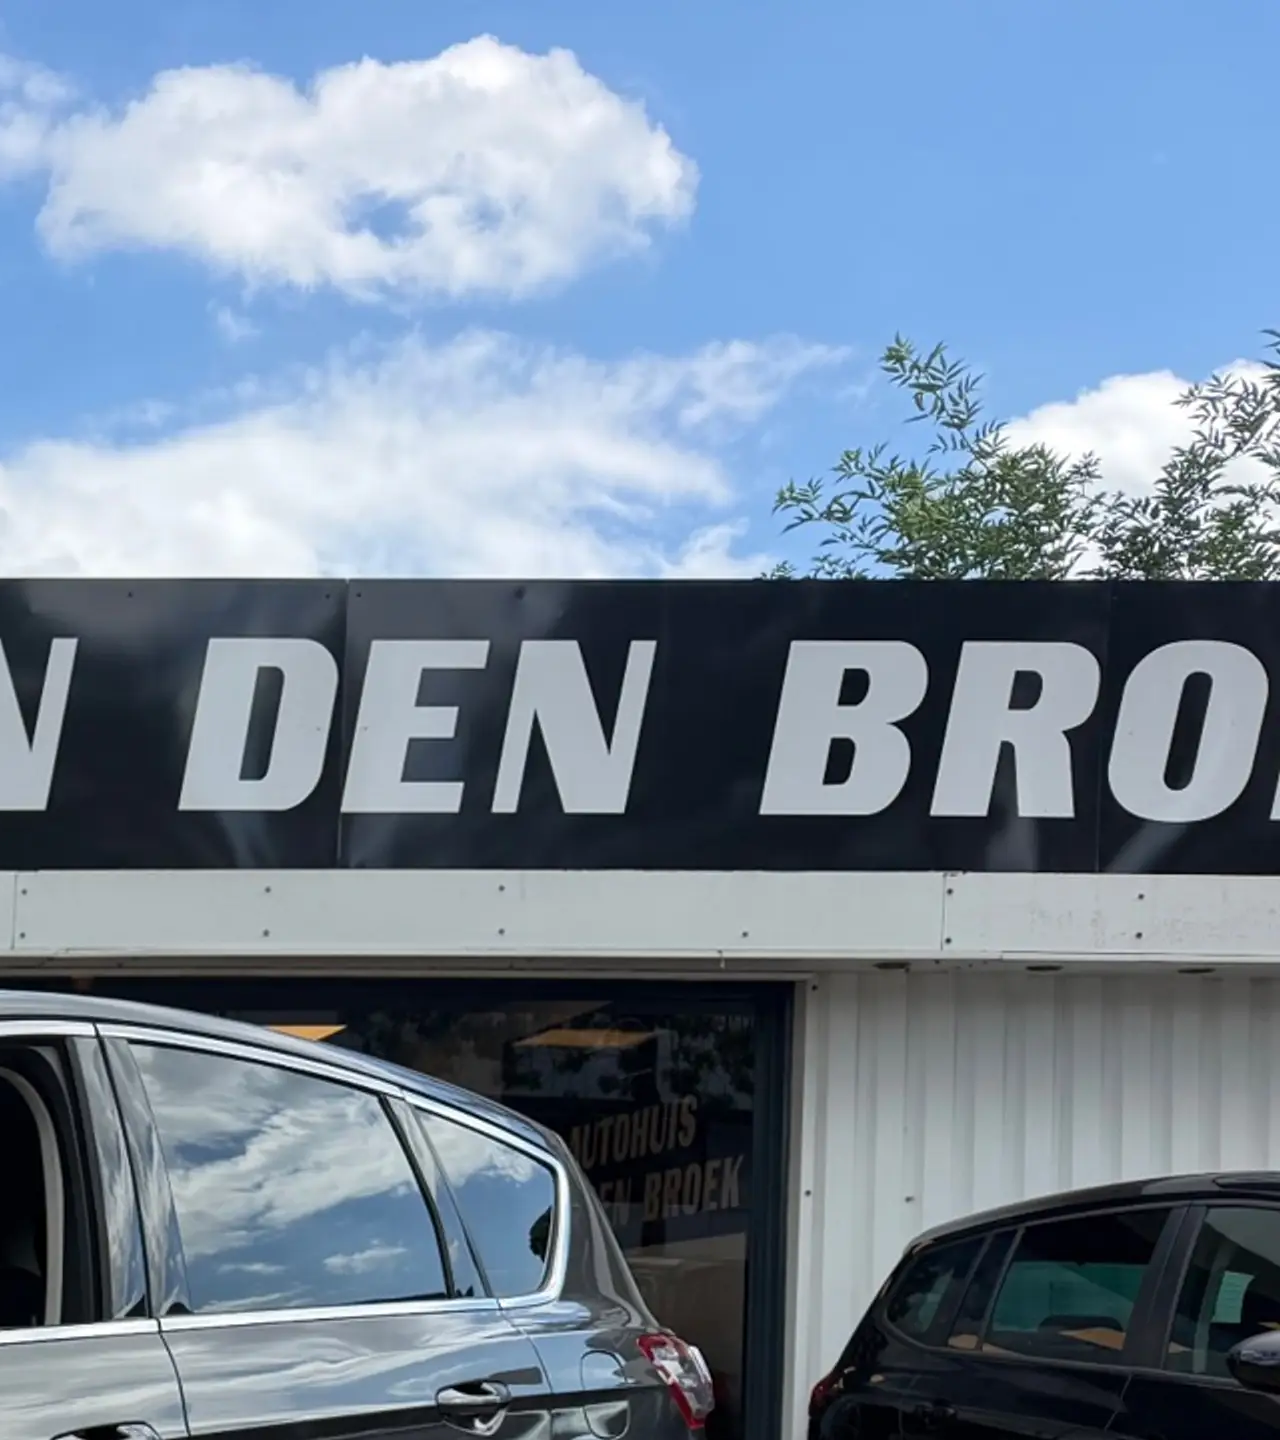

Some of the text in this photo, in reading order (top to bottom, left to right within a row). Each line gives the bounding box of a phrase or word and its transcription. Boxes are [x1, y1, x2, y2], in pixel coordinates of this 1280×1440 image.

[179, 638, 656, 813] DEN
[760, 641, 1280, 822] BRO
[644, 1153, 745, 1221] BROEK
